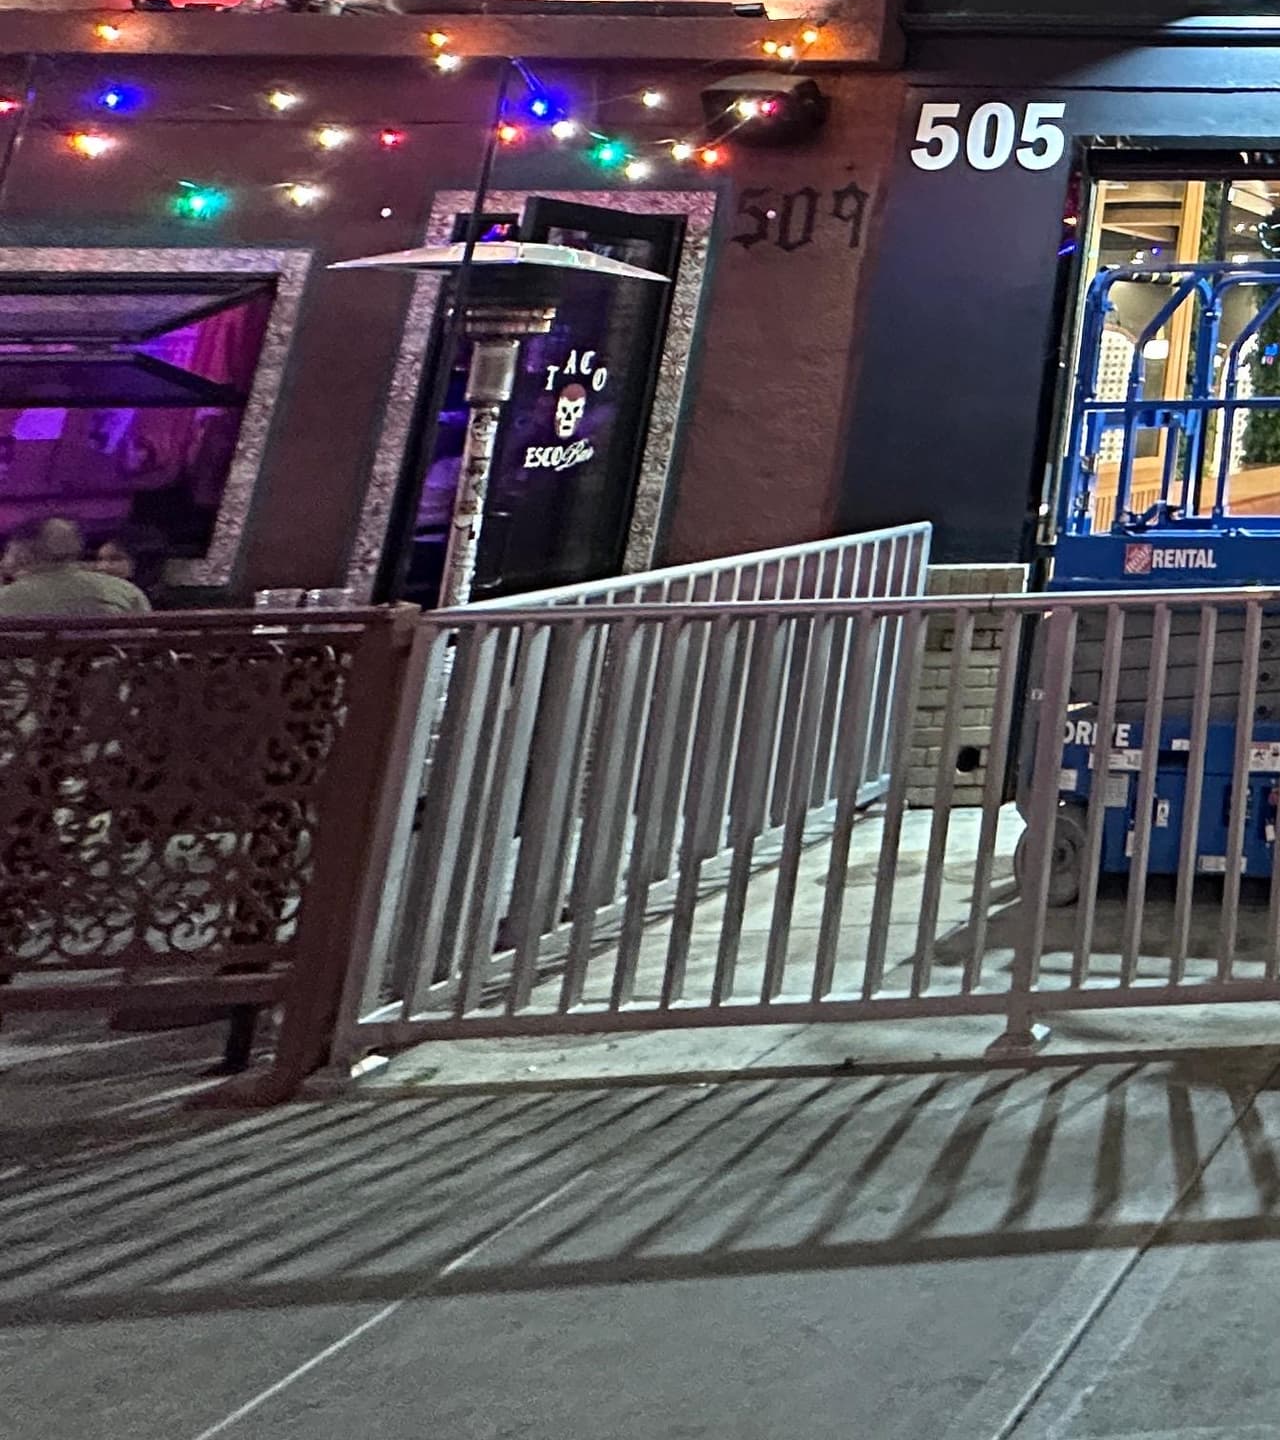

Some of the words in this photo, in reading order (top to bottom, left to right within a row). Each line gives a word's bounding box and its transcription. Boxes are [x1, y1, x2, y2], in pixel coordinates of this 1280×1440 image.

[911, 103, 1066, 170] 505
[731, 182, 869, 251] 509
[545, 349, 607, 391] TACO
[1152, 549, 1217, 569] RENTAL
[1064, 721, 1131, 747] DRIE
